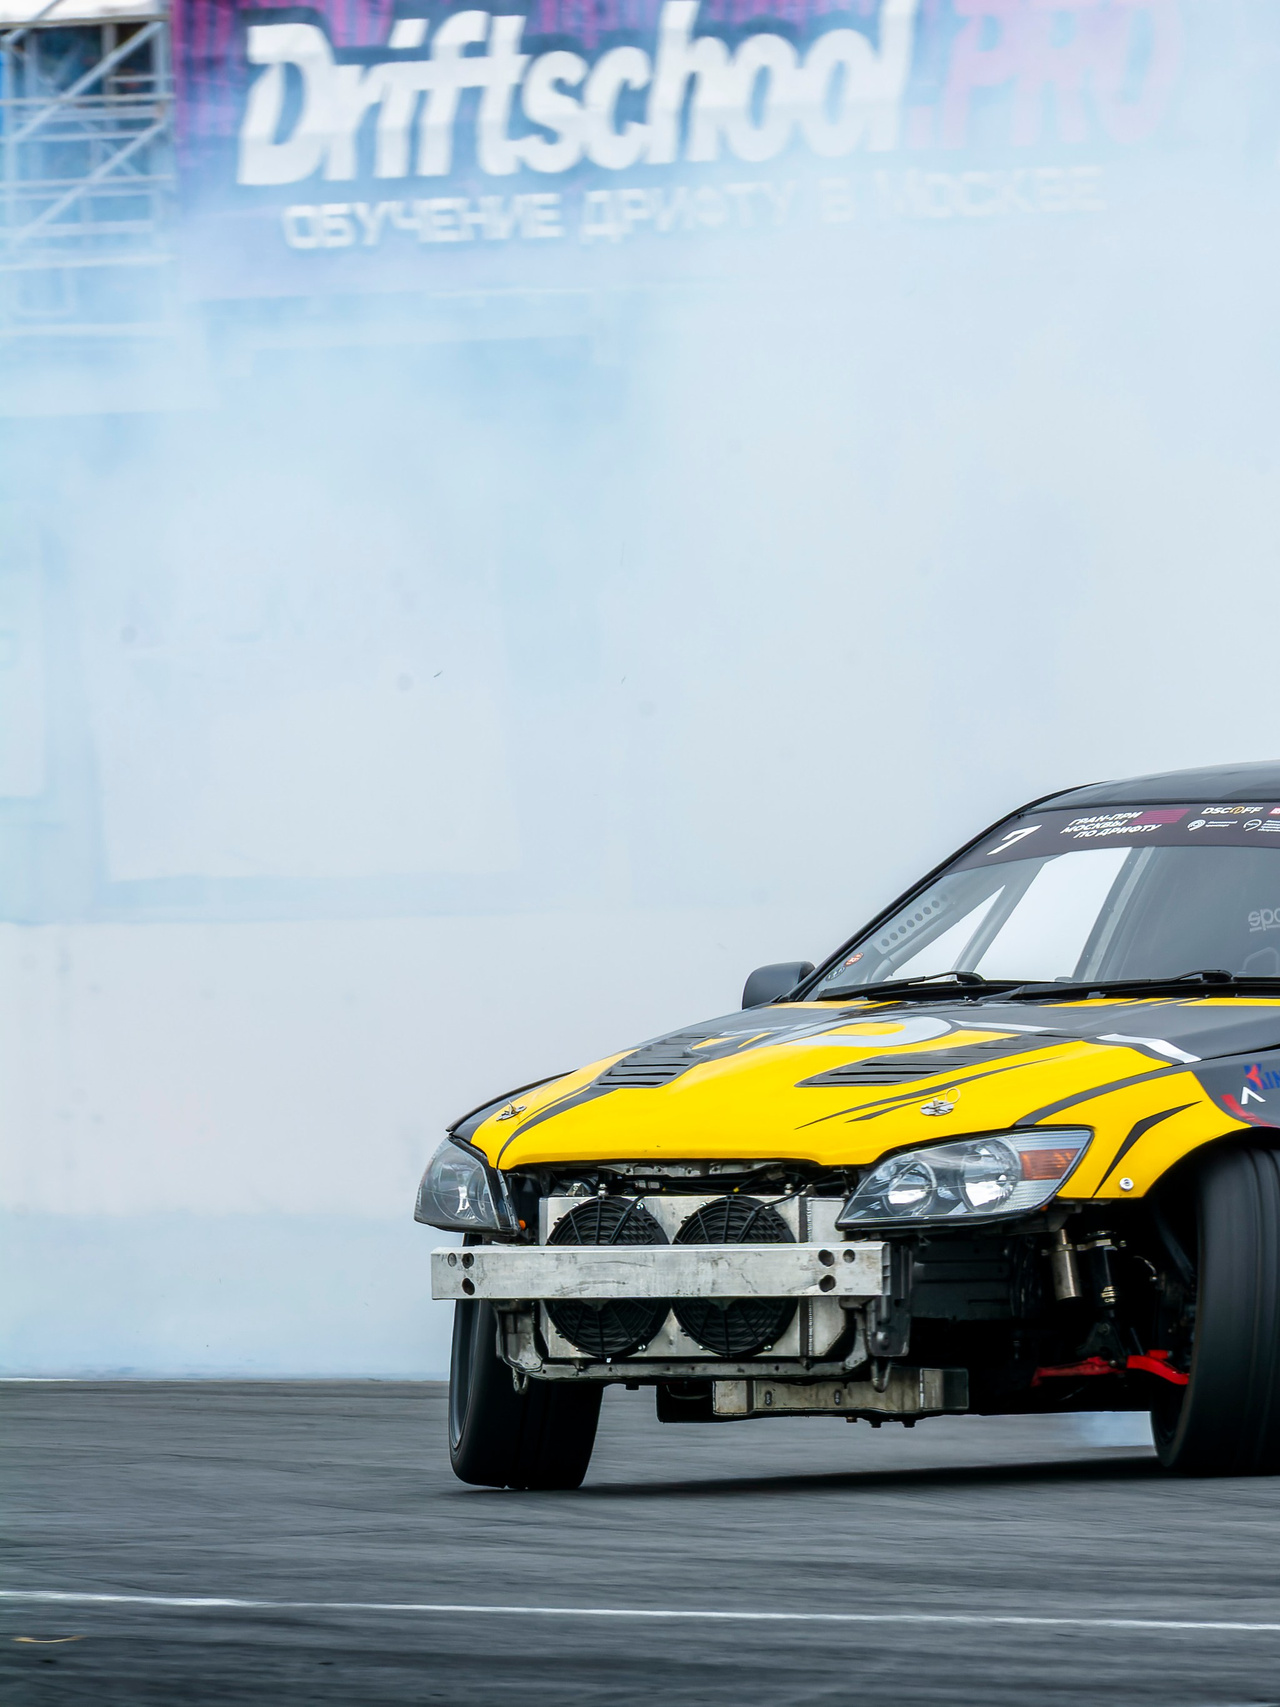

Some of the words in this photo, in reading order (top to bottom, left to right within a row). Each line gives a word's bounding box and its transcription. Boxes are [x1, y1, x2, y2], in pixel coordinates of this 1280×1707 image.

[283, 191, 563, 249] ОБУЧЕНИЕ
[1059, 819, 1129, 834] МОСКВЫ
[1068, 811, 1144, 826] ГРАН-ПРИ
[1073, 829, 1098, 839] ПО
[1094, 823, 1163, 837] ДРИФТУ
[986, 824, 1043, 856] 7
